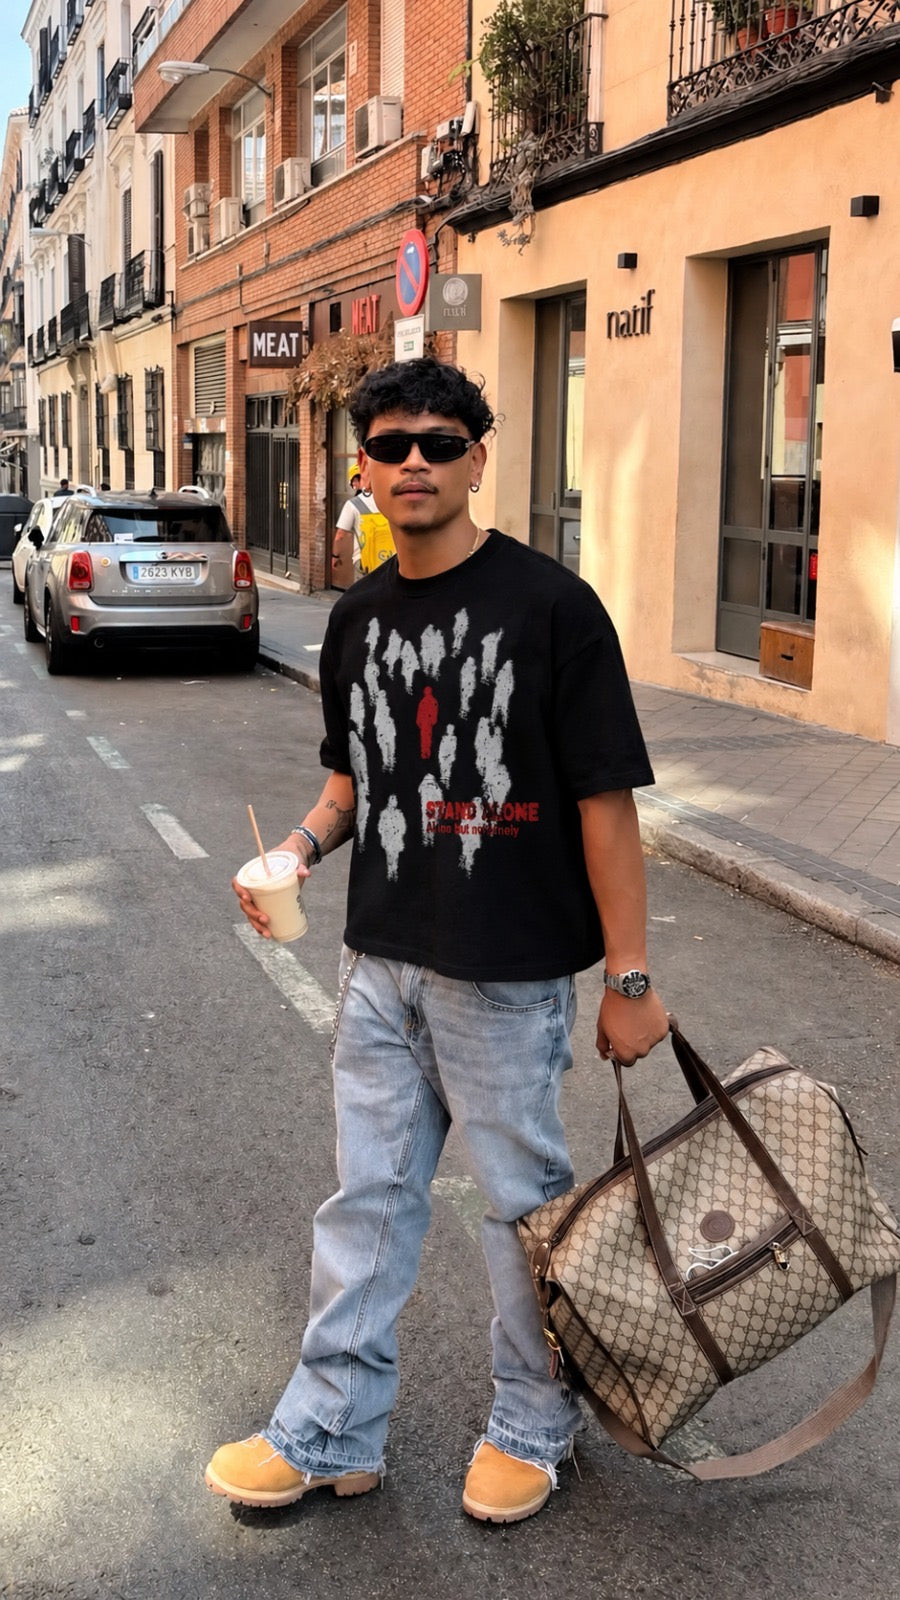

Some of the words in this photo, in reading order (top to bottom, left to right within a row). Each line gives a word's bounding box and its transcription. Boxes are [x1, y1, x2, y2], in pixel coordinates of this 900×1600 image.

[351, 294, 380, 336] MEAT
[606, 288, 656, 340] natif
[252, 332, 299, 357] MEAT
[140, 566, 168, 578] 2623
[171, 566, 193, 578] KYB
[425, 800, 477, 821] STAND
[481, 801, 539, 822] ALONE
[453, 822, 470, 835] but
